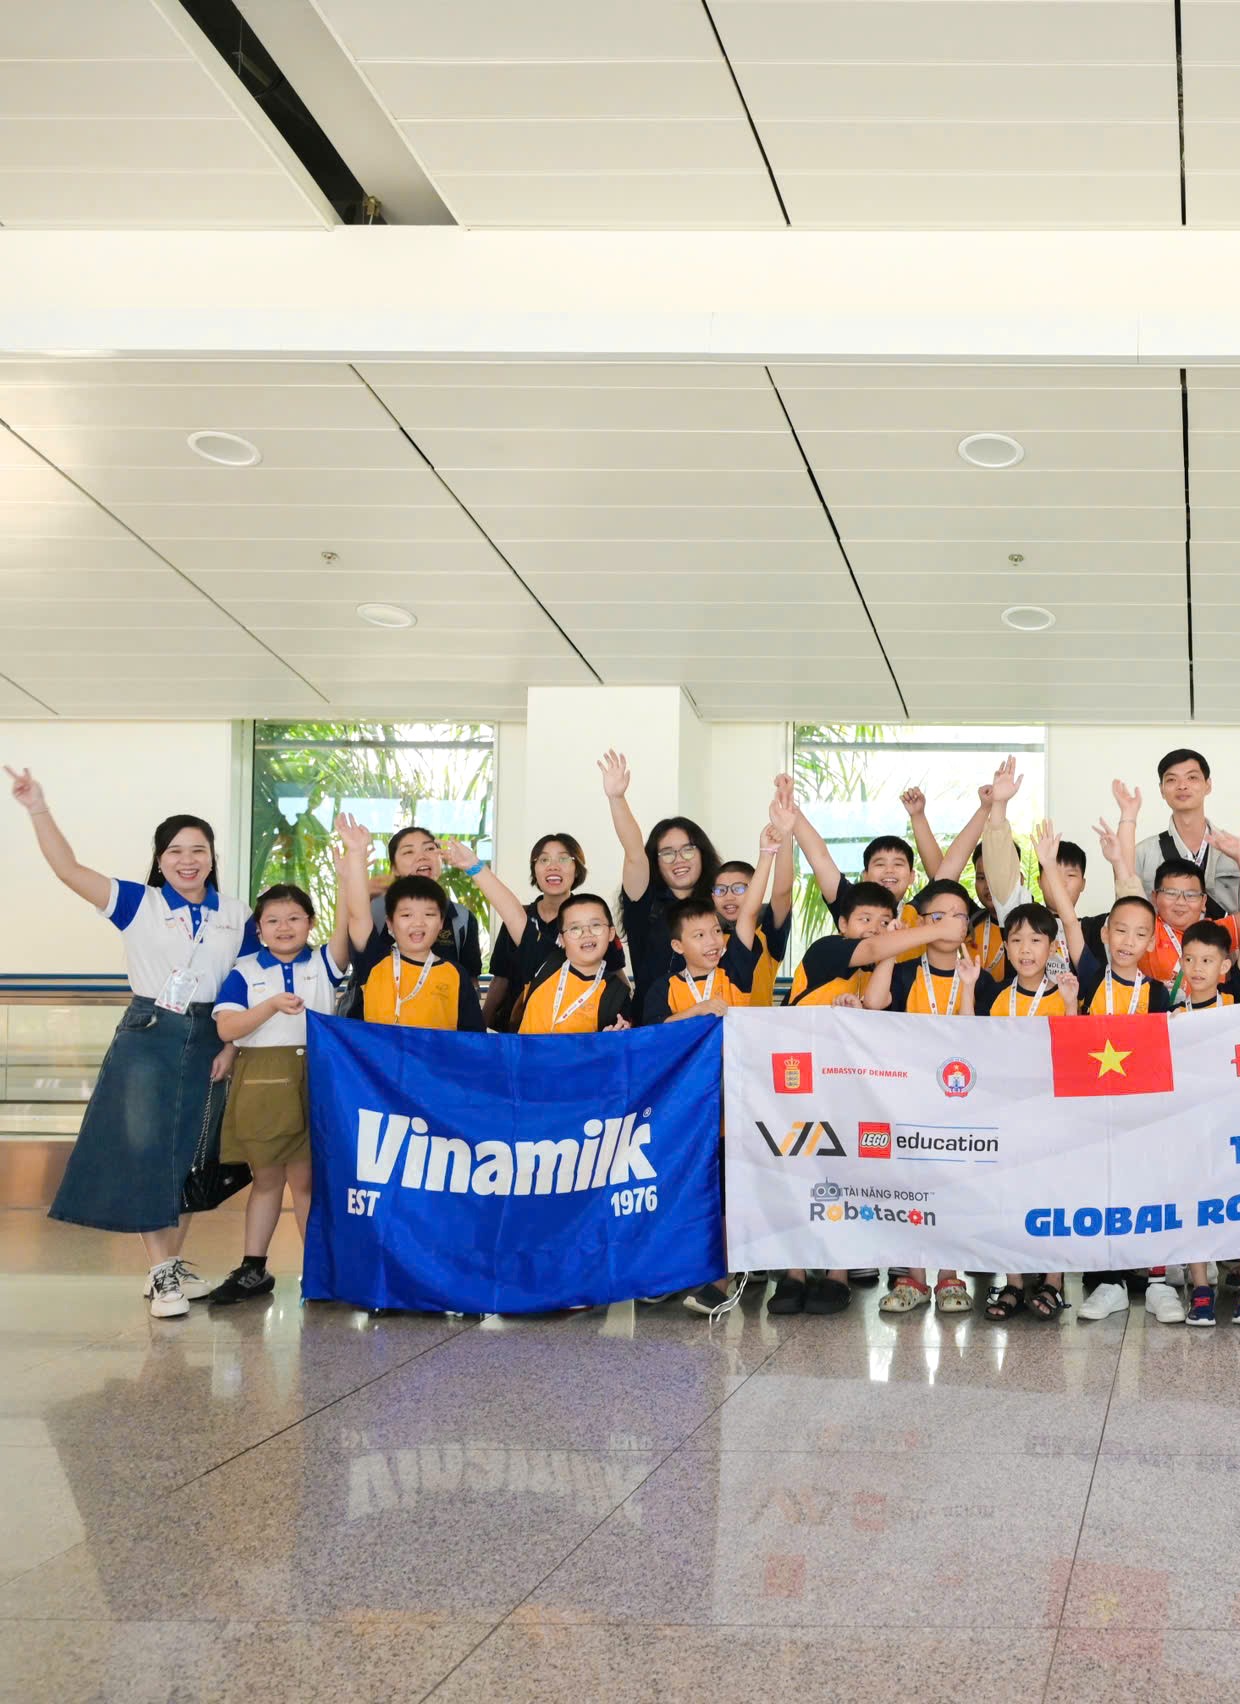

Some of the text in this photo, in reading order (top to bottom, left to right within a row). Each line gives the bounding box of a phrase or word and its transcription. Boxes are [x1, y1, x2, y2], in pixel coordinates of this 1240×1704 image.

[822, 1067, 856, 1075] EMBASSY
[869, 1069, 908, 1078] DENMARK
[356, 1108, 658, 1196] Vinamilk
[861, 1132, 889, 1147] LEGO
[896, 1132, 999, 1152] education
[347, 1188, 381, 1217] EST
[611, 1185, 658, 1217] 1976
[843, 1185, 929, 1202] TÀI NĂNG ROBOT
[810, 1201, 936, 1226] Robotacon
[1024, 1203, 1184, 1238] GLOBAL
